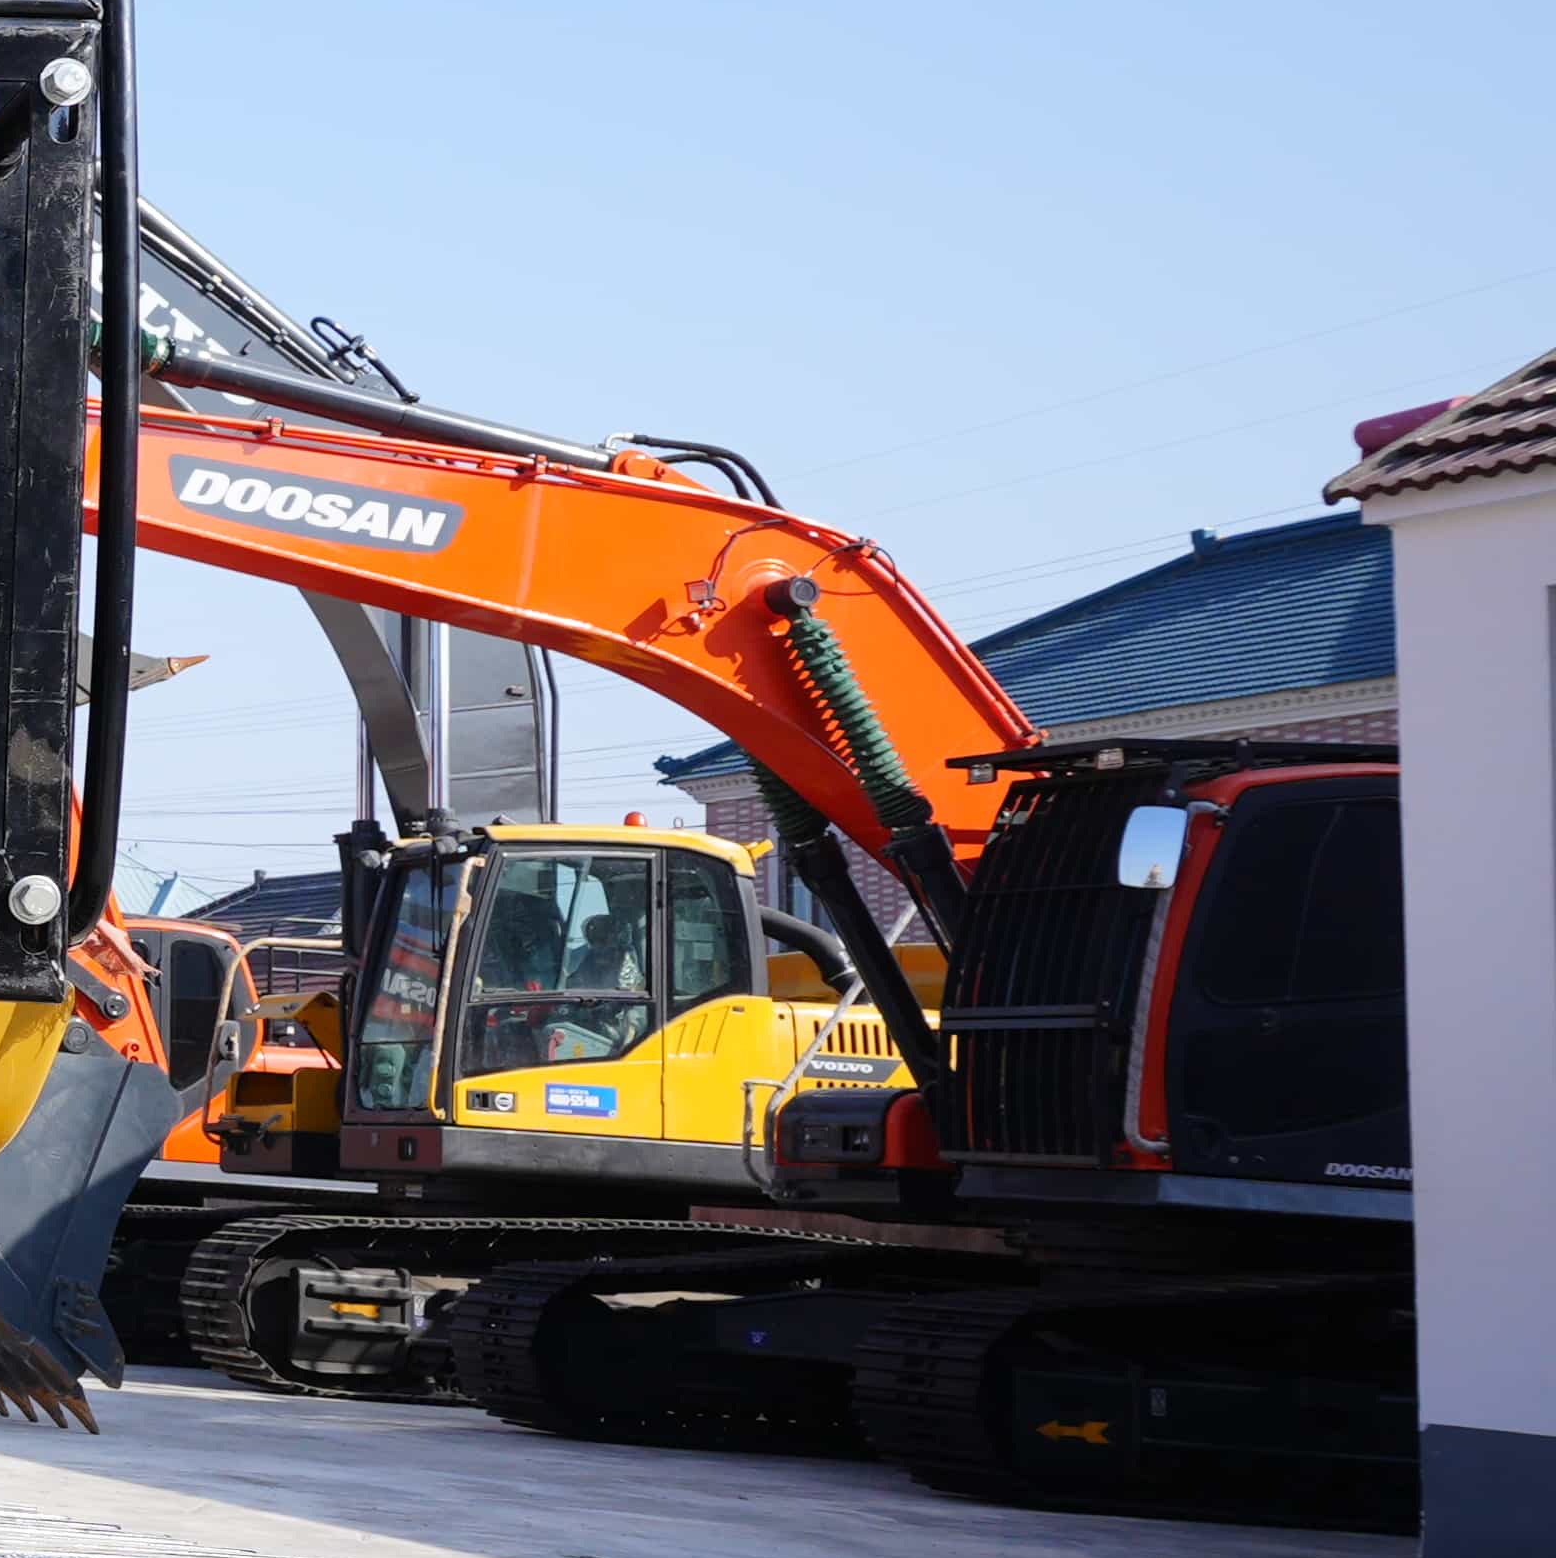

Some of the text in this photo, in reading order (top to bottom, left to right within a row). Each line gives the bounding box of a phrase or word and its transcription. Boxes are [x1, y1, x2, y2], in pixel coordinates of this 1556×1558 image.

[179, 469, 446, 546] DOOSAN
[810, 1060, 873, 1074] VOLVO
[1324, 1163, 1412, 1180] DOOSAN
